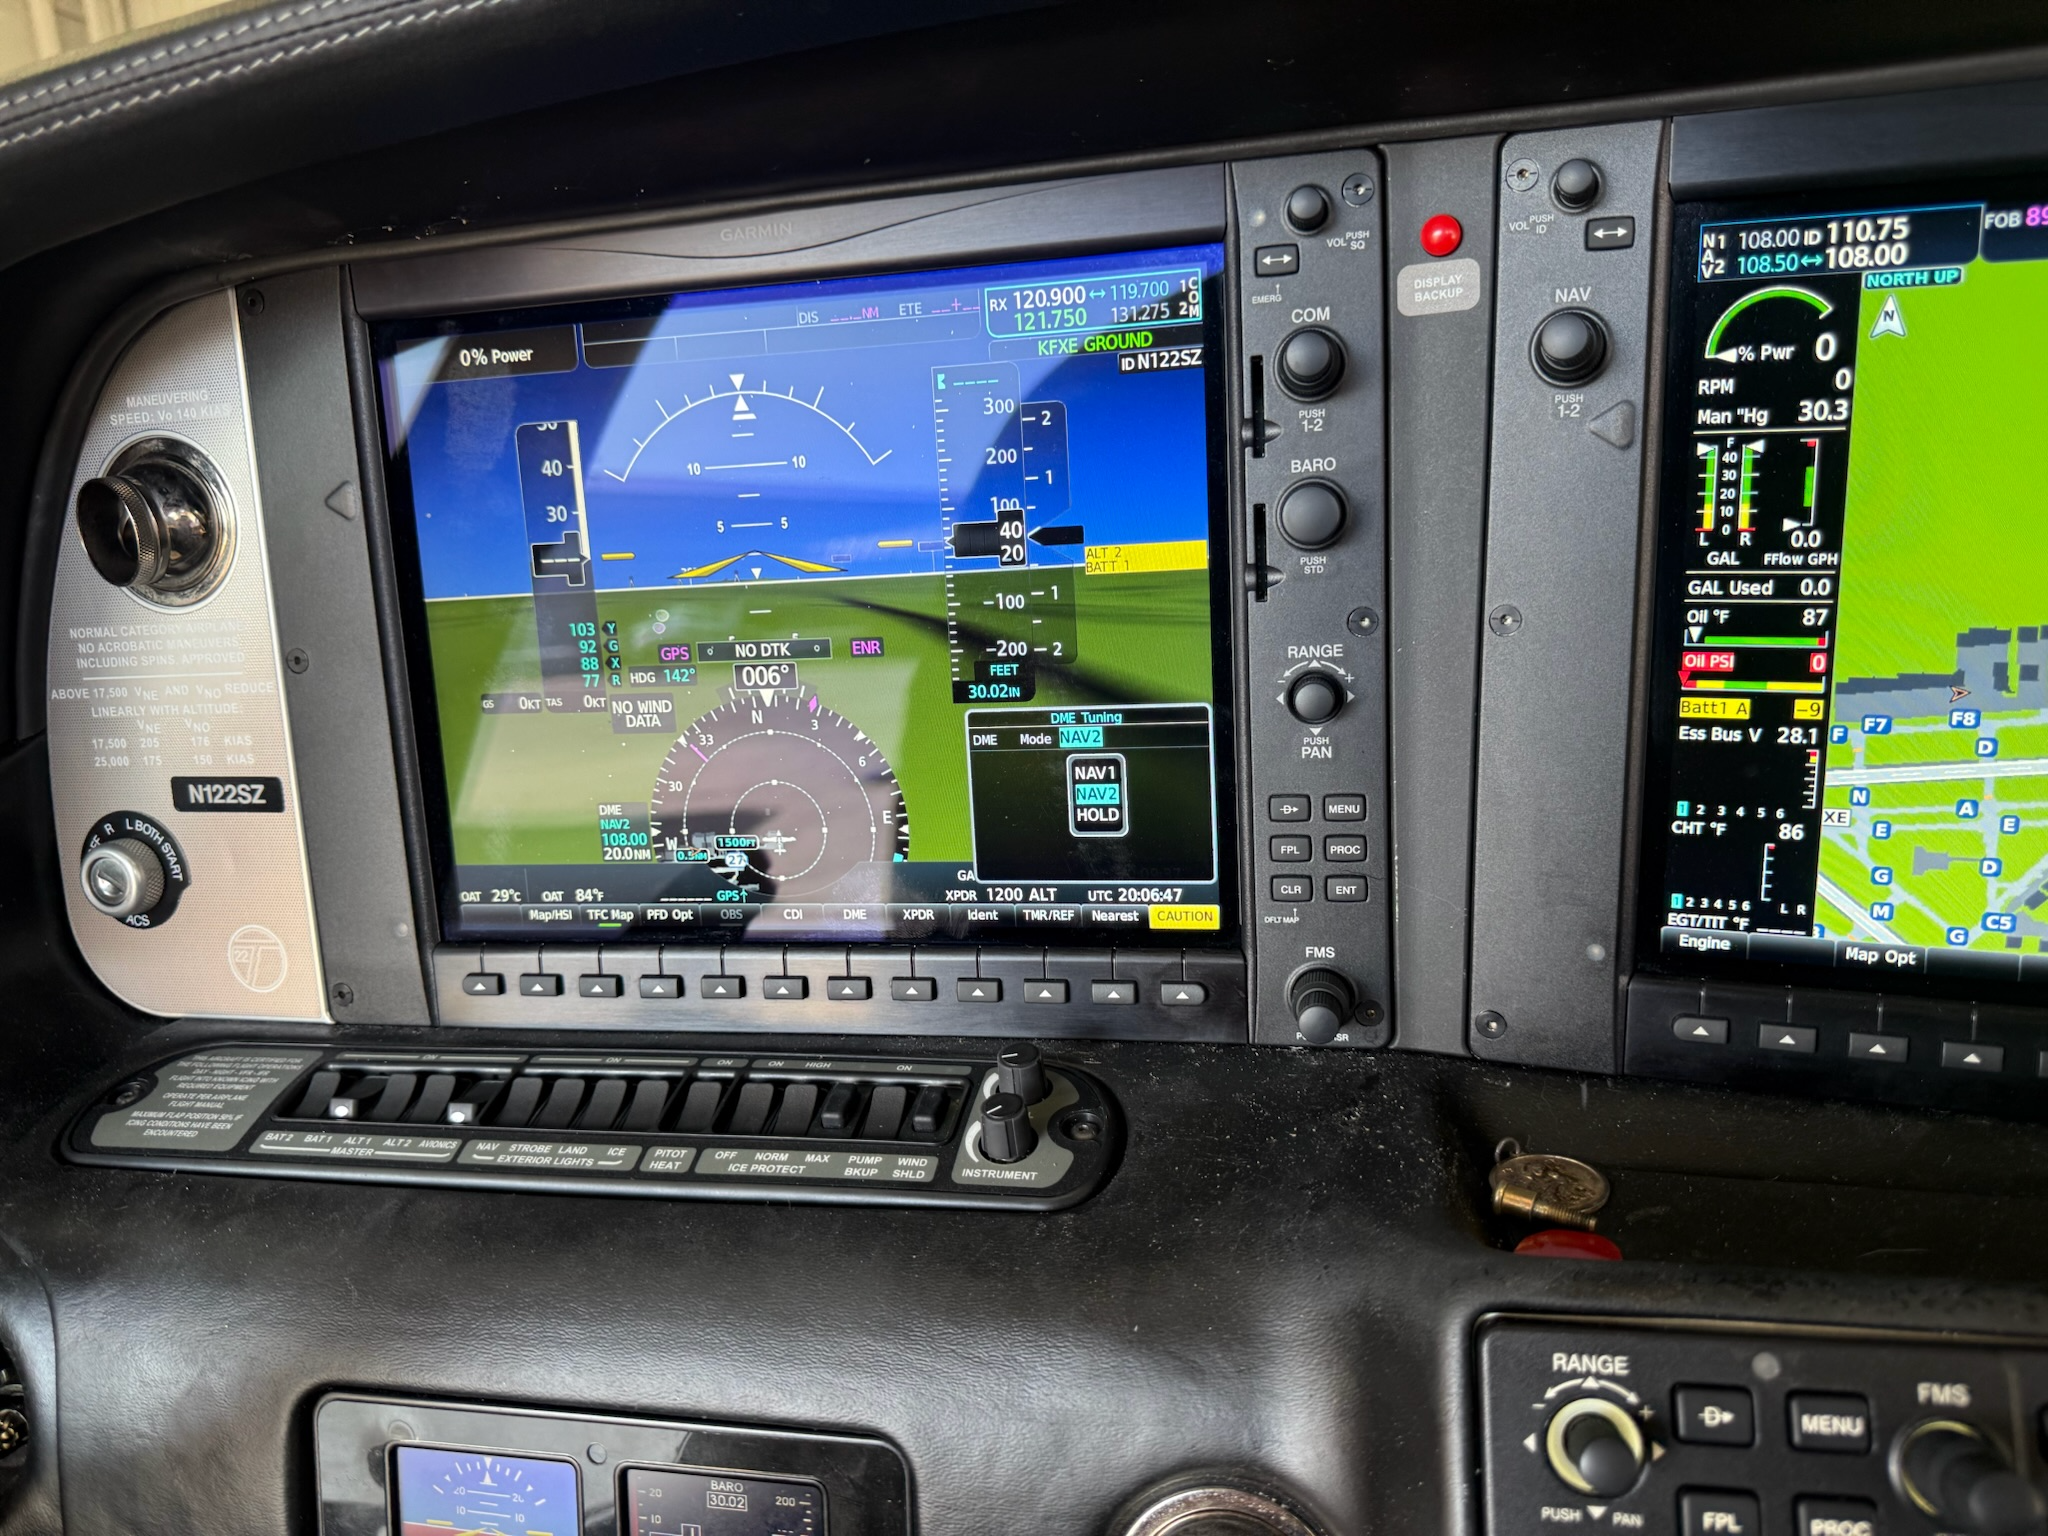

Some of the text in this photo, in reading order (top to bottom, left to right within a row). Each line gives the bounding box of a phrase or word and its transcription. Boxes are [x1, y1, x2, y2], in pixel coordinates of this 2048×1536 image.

[720, 222, 794, 242] GARMIN
[1739, 217, 1909, 249] 108.00 110.75
[1738, 243, 1908, 274] 108.50 108.00
[1414, 274, 1462, 289] DISPLAY
[1866, 272, 1928, 287] NORTH
[990, 281, 1169, 312] RX 120.900 119.700
[1415, 287, 1463, 302] BACKUP
[1555, 287, 1592, 302] NAV
[899, 303, 922, 315] ETE
[1291, 307, 1330, 323] COM
[1014, 305, 1170, 331] 121.750 131.275
[1038, 331, 1153, 356] KFXE GROUND
[492, 348, 534, 364] Power
[1138, 350, 1202, 369] N122SZ
[1698, 379, 1734, 395] RPM
[126, 390, 208, 408] MANEUVERING
[983, 398, 1015, 414] 300
[1698, 400, 1848, 425] Man 30.3
[110, 405, 230, 426] SPEED: 140 KIAS
[1299, 409, 1325, 419] PUSH
[986, 449, 1017, 464] 200
[541, 460, 562, 476] 40
[1291, 458, 1336, 473] BARO
[547, 506, 567, 522] 30
[1791, 531, 1821, 547] 0.0
[1086, 548, 1108, 558] ALT
[1707, 552, 1740, 565] GAL
[1808, 554, 1838, 565] GPH
[1085, 561, 1116, 573] BATT
[1300, 556, 1327, 565] PUSH
[1304, 565, 1324, 574] STD
[1688, 579, 1830, 595] GAL Used 0.0
[1687, 609, 1828, 626] Oil 87
[70, 624, 181, 639] NORMAL CATEGORY
[569, 623, 595, 637] 103
[78, 638, 239, 653] NO ACROBATIC MANEUVERS
[760, 643, 791, 656] DTK
[852, 641, 881, 655] ENR
[1287, 644, 1344, 658] RANGE
[661, 647, 690, 660] GPS
[77, 652, 245, 669] INCLUDING APPROVED
[1684, 654, 1734, 668] Oil PSI
[990, 664, 1018, 675] FEET
[630, 672, 656, 683] HDG
[52, 682, 273, 699] ABOVE 17,500 AND REDUCE
[92, 705, 179, 718] LINEARLY WITH
[612, 701, 672, 714] NO WIND
[1681, 700, 1727, 715] Batt1
[626, 715, 662, 727] DATA
[1051, 712, 1122, 724] DME Tuning
[1951, 711, 1976, 726] F8
[1864, 718, 1887, 732] F7
[973, 733, 1052, 746] DME Mode
[1304, 737, 1329, 745] PUSH
[1679, 726, 1817, 744] Ess Bus 28.1
[92, 735, 252, 750] 17,500 205 KIAS
[1301, 746, 1332, 758] PAN
[95, 754, 254, 768] 25,000 175 KIAS
[1075, 765, 1116, 780] NAV1
[188, 784, 266, 804] N122SZ
[1077, 807, 1119, 822] HOLD
[1329, 805, 1360, 814] MENU
[600, 819, 631, 830] NAV2
[1671, 821, 1804, 840] CHT 86
[602, 833, 647, 846] 108.00
[1280, 846, 1300, 854] FPL
[1330, 845, 1361, 855] PROC
[946, 888, 1057, 901] XPDR 1200 ALT
[1088, 888, 1182, 902] UTC 20:06:47
[1280, 885, 1302, 894] CLR
[1336, 886, 1356, 894] ENT
[530, 910, 573, 921] Map/HSI
[587, 910, 634, 922] TFC Map
[647, 910, 694, 921] PFD Opt
[783, 909, 803, 921] CDI
[843, 909, 867, 921] DME
[903, 909, 934, 921] XPDR
[968, 910, 998, 920] Ident
[1023, 910, 1074, 921] TMR/REF
[1092, 910, 1139, 922] Nearest
[1157, 910, 1213, 922] CAUTION
[1667, 912, 1728, 929] EGT/TIT
[1679, 934, 1731, 951] Engine
[1305, 947, 1335, 958] FMS
[1845, 947, 1917, 965] Map Opt
[383, 1138, 404, 1146] ALT
[419, 1140, 458, 1149] AVIONICS
[509, 1144, 552, 1153] STROBE
[330, 1147, 374, 1156] MASTER
[558, 1146, 588, 1154] LAND
[654, 1149, 688, 1159] PITOT
[715, 1151, 738, 1160] OFF
[755, 1152, 789, 1161] NORM
[497, 1155, 594, 1166] EXTERIOR LIGHTS
[805, 1154, 830, 1163] MAX
[848, 1156, 882, 1164] PUMP
[898, 1158, 927, 1166] WIND
[650, 1161, 682, 1170] HEAT
[750, 1164, 806, 1174] PROTECT
[844, 1168, 878, 1177] BKUP
[892, 1170, 925, 1179] SHLD
[962, 1169, 1038, 1180] INSTRUMENT
[1553, 1353, 1629, 1376] RANGE
[1917, 1383, 1971, 1407] FMS
[1801, 1415, 1863, 1437] MENU
[710, 1480, 743, 1492] BARO
[710, 1494, 745, 1508] 30.02
[1703, 1512, 1744, 1533] FPL
